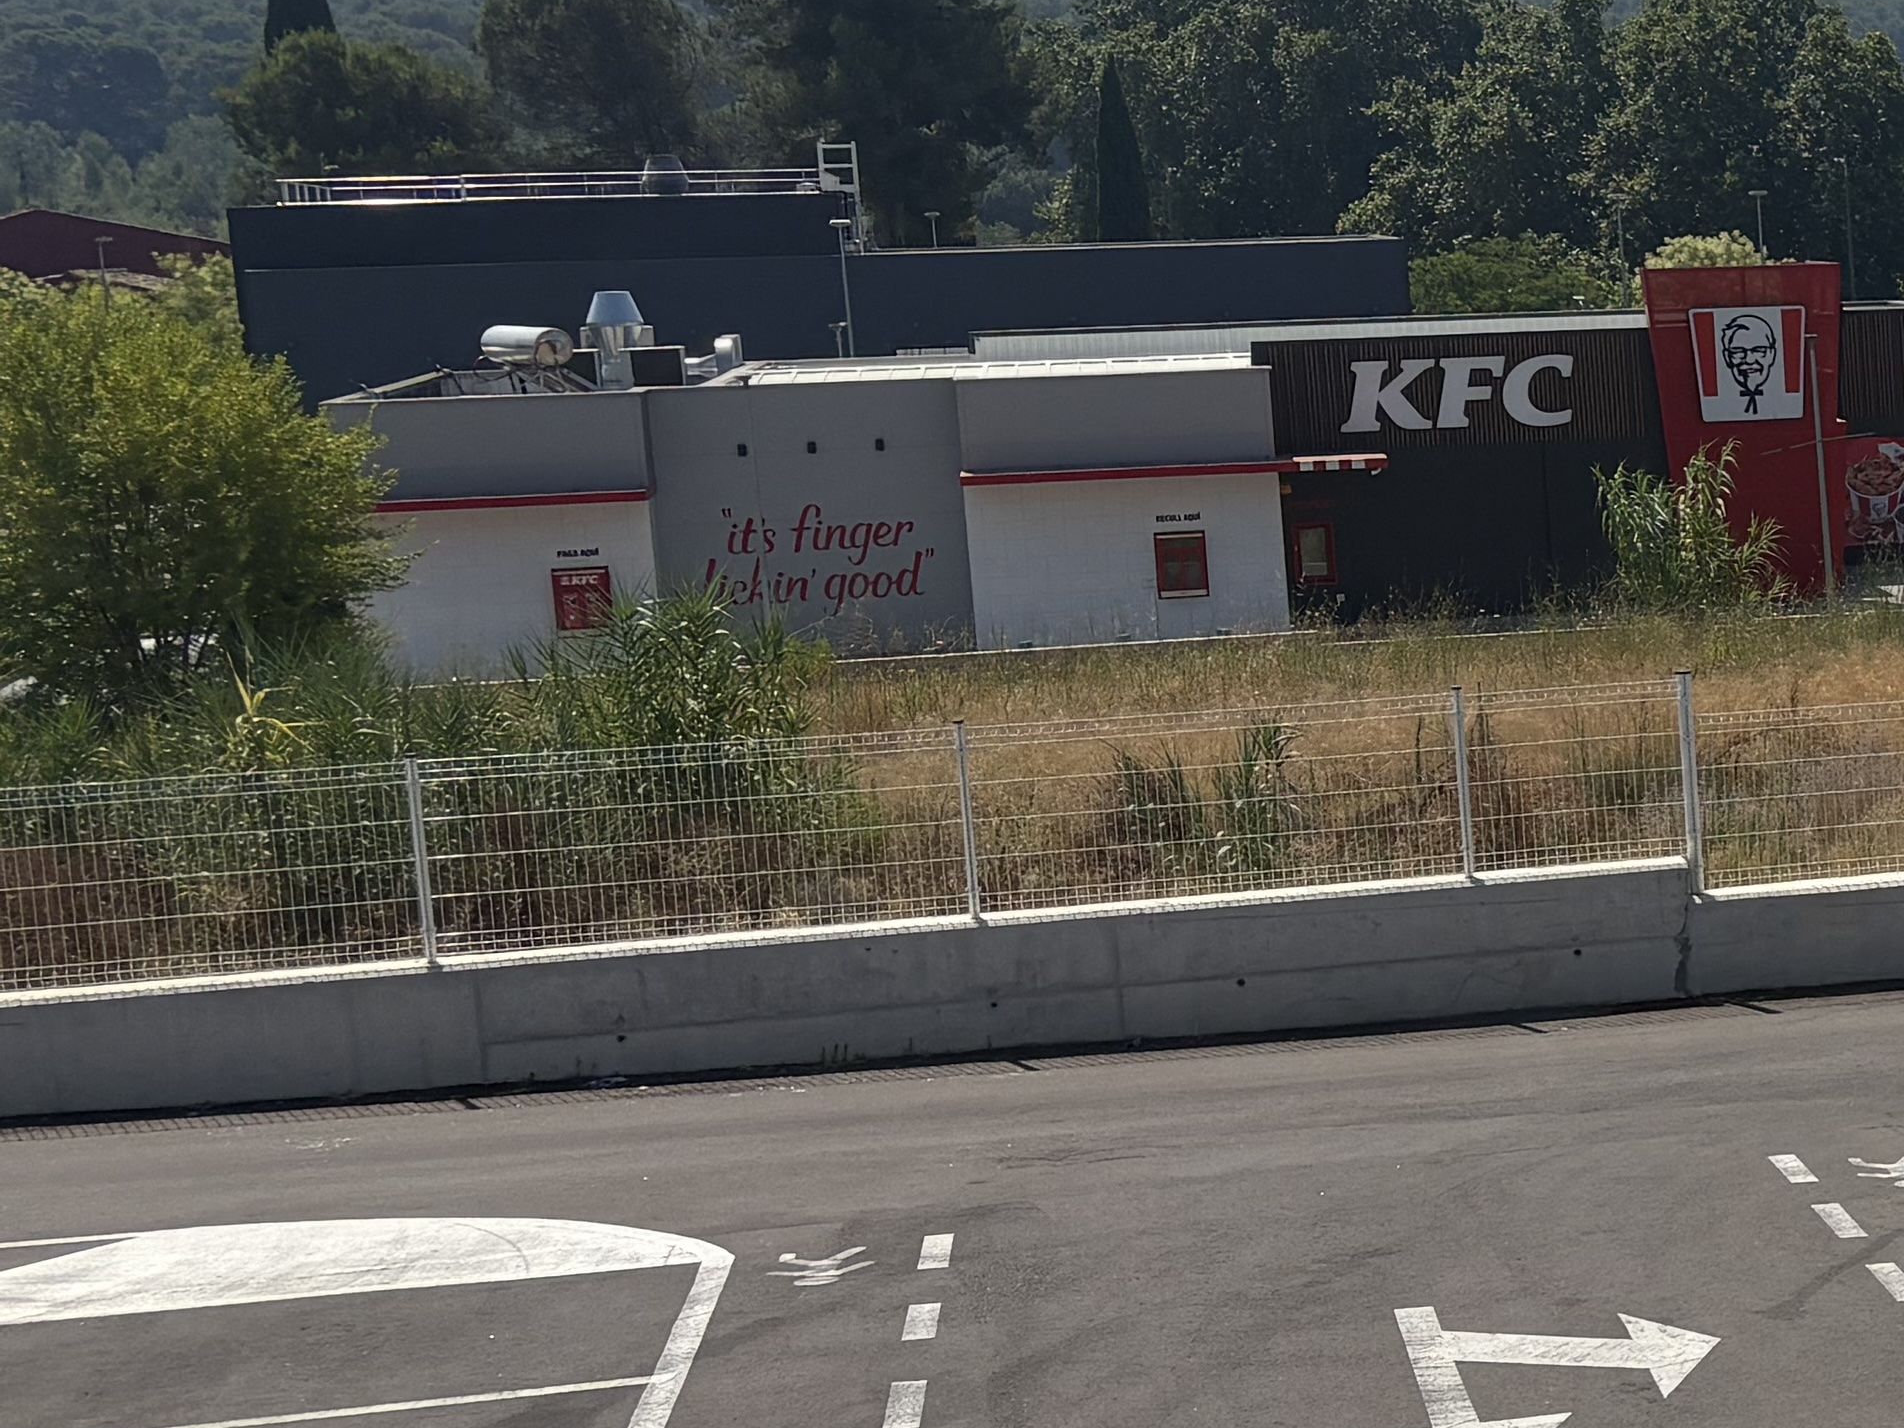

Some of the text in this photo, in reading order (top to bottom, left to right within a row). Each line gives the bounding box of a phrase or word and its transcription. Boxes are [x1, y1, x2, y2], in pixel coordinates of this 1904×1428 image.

[1340, 354, 1574, 433] KFC
[790, 503, 915, 566] finger
[823, 547, 934, 616] good"
